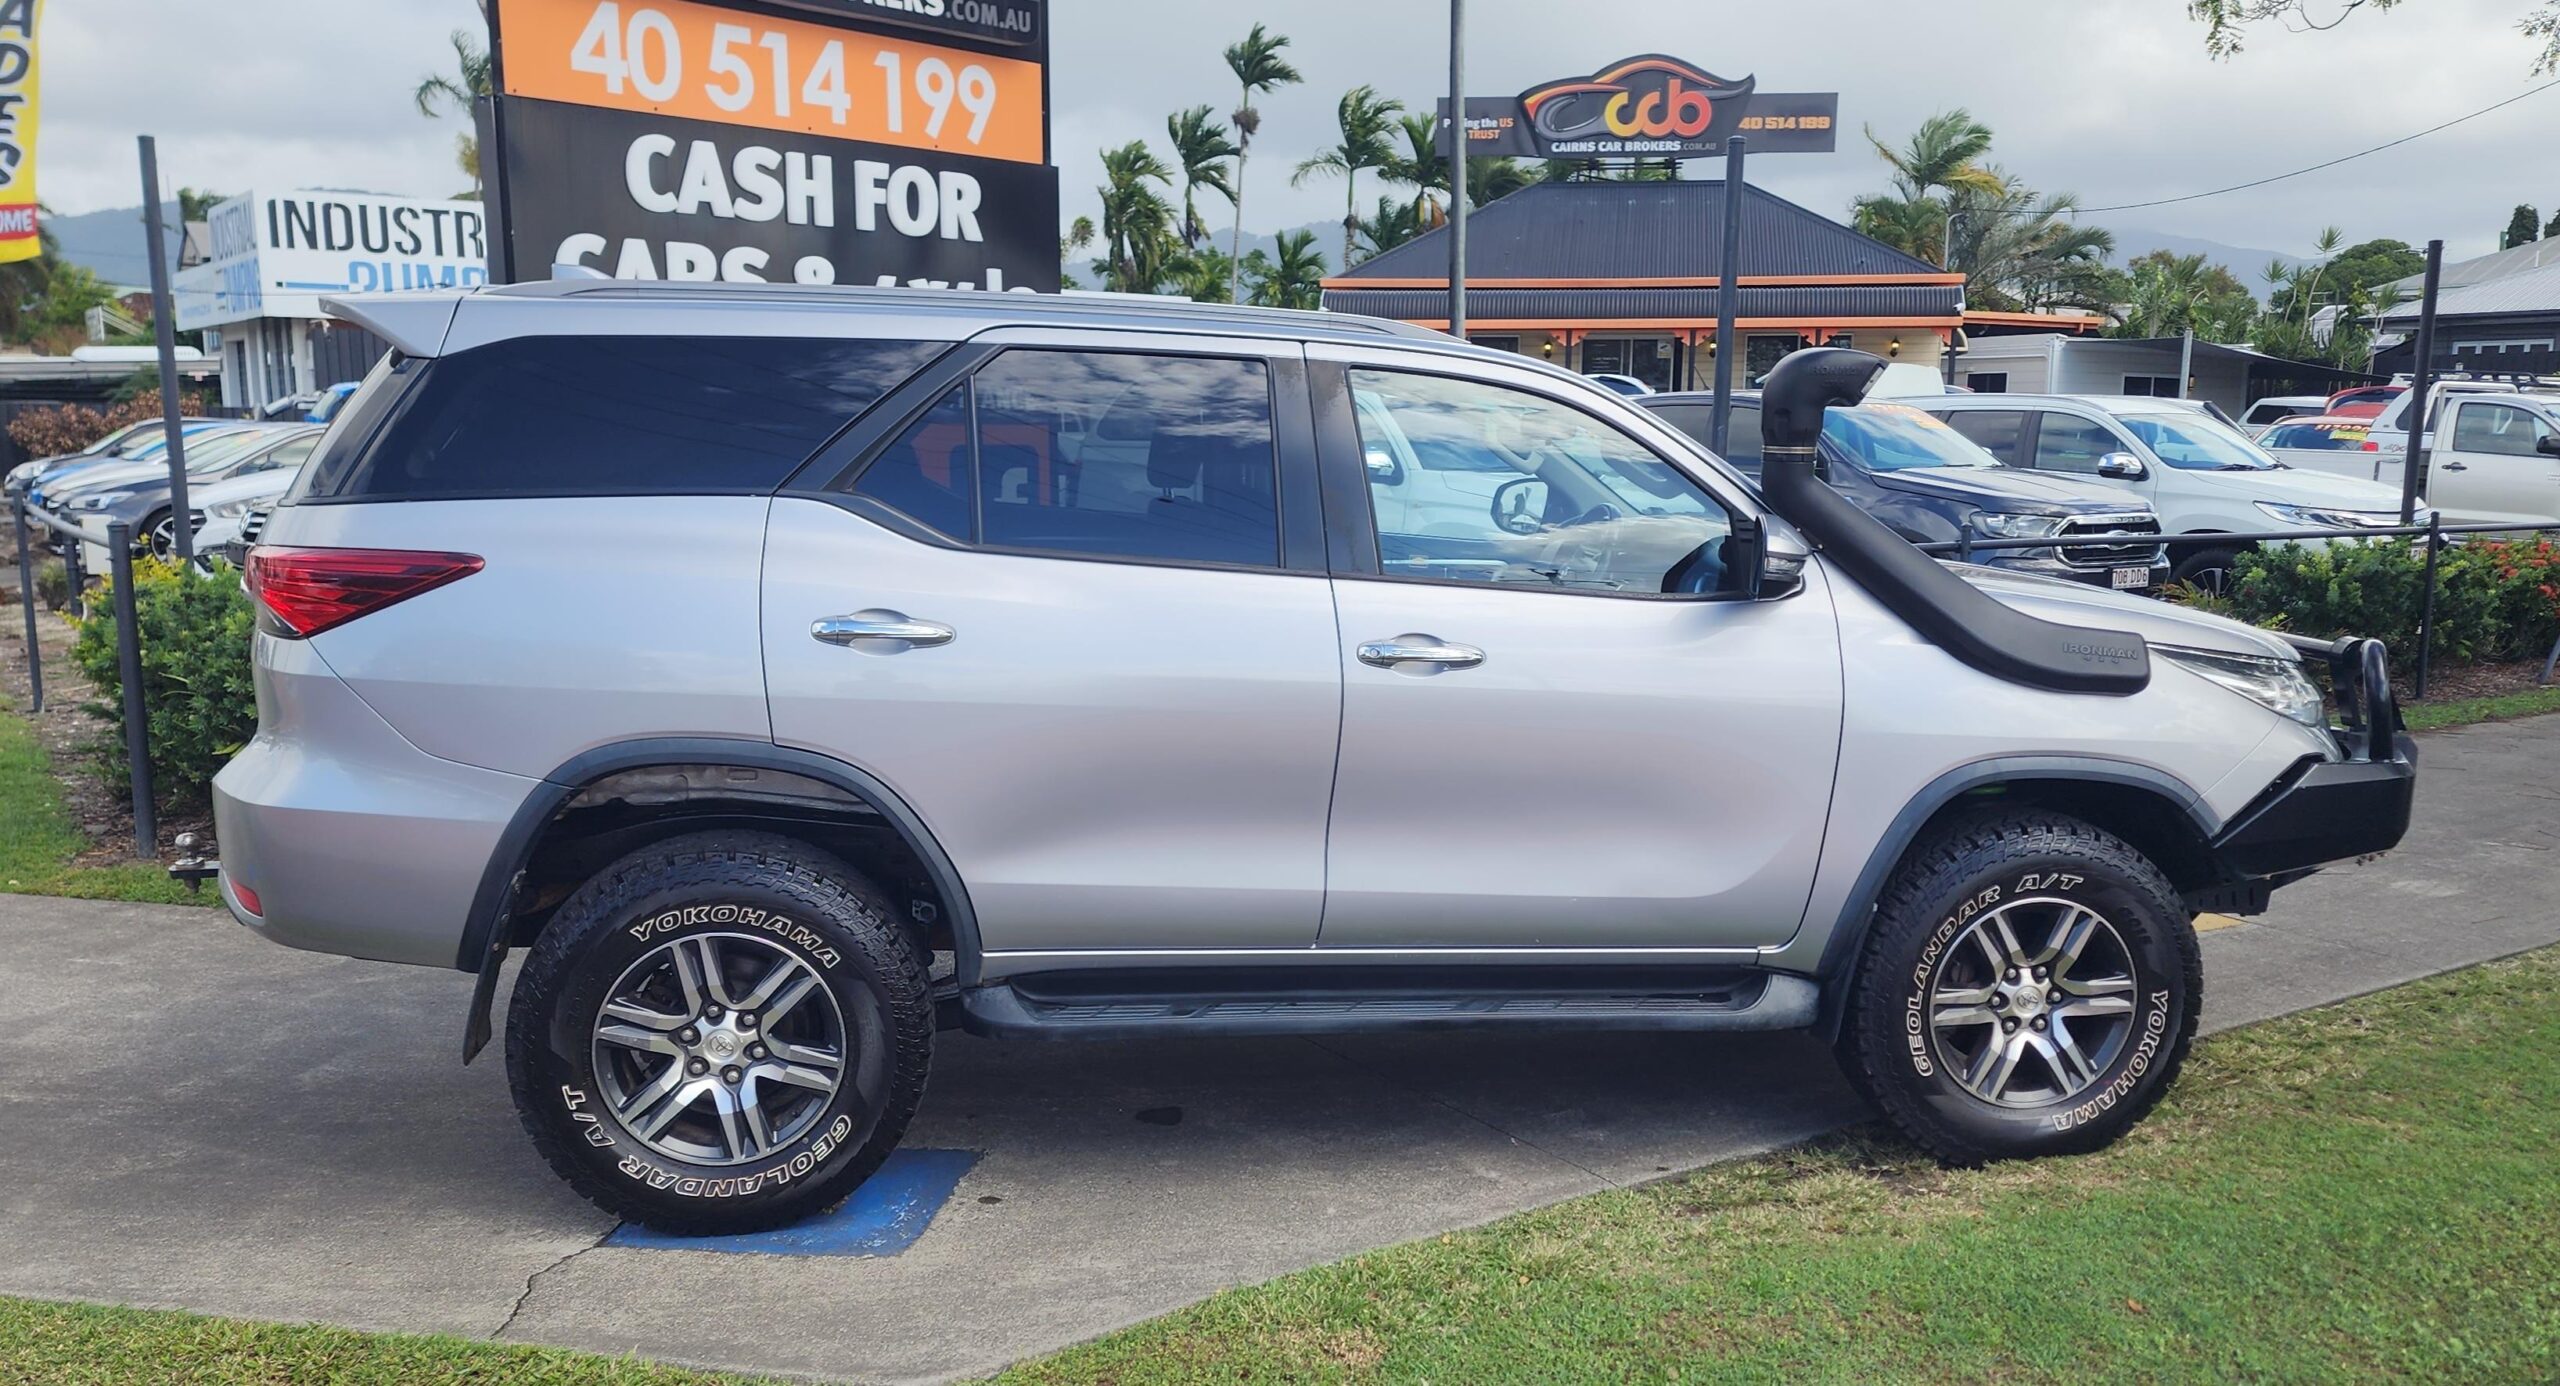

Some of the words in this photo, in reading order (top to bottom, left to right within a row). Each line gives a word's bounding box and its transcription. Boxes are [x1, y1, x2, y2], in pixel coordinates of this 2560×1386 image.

[570, 2, 682, 102] 40
[705, 22, 852, 125] 514
[874, 50, 997, 145] 199
[1468, 129, 1501, 139] TRUST
[1481, 117, 1498, 128] the
[1499, 117, 1514, 128] US
[1551, 141, 1596, 152] CAIRNS
[1597, 141, 1622, 152] CAR
[1738, 116, 1763, 129] 40
[1764, 116, 1797, 129] 514
[625, 133, 834, 228] CASH
[853, 159, 983, 243] FOR
[2130, 568, 2147, 584] DD6
[2062, 642, 2138, 660] IRONMAN
[630, 905, 841, 969] YOKOHAMA
[1906, 884, 2001, 1077] GEOLANDAR
[2015, 873, 2084, 895] A/T
[2052, 989, 2169, 1132] YOKOHAMA
[561, 1084, 616, 1149] A/T
[618, 1114, 853, 1198] GEOLANDAR
